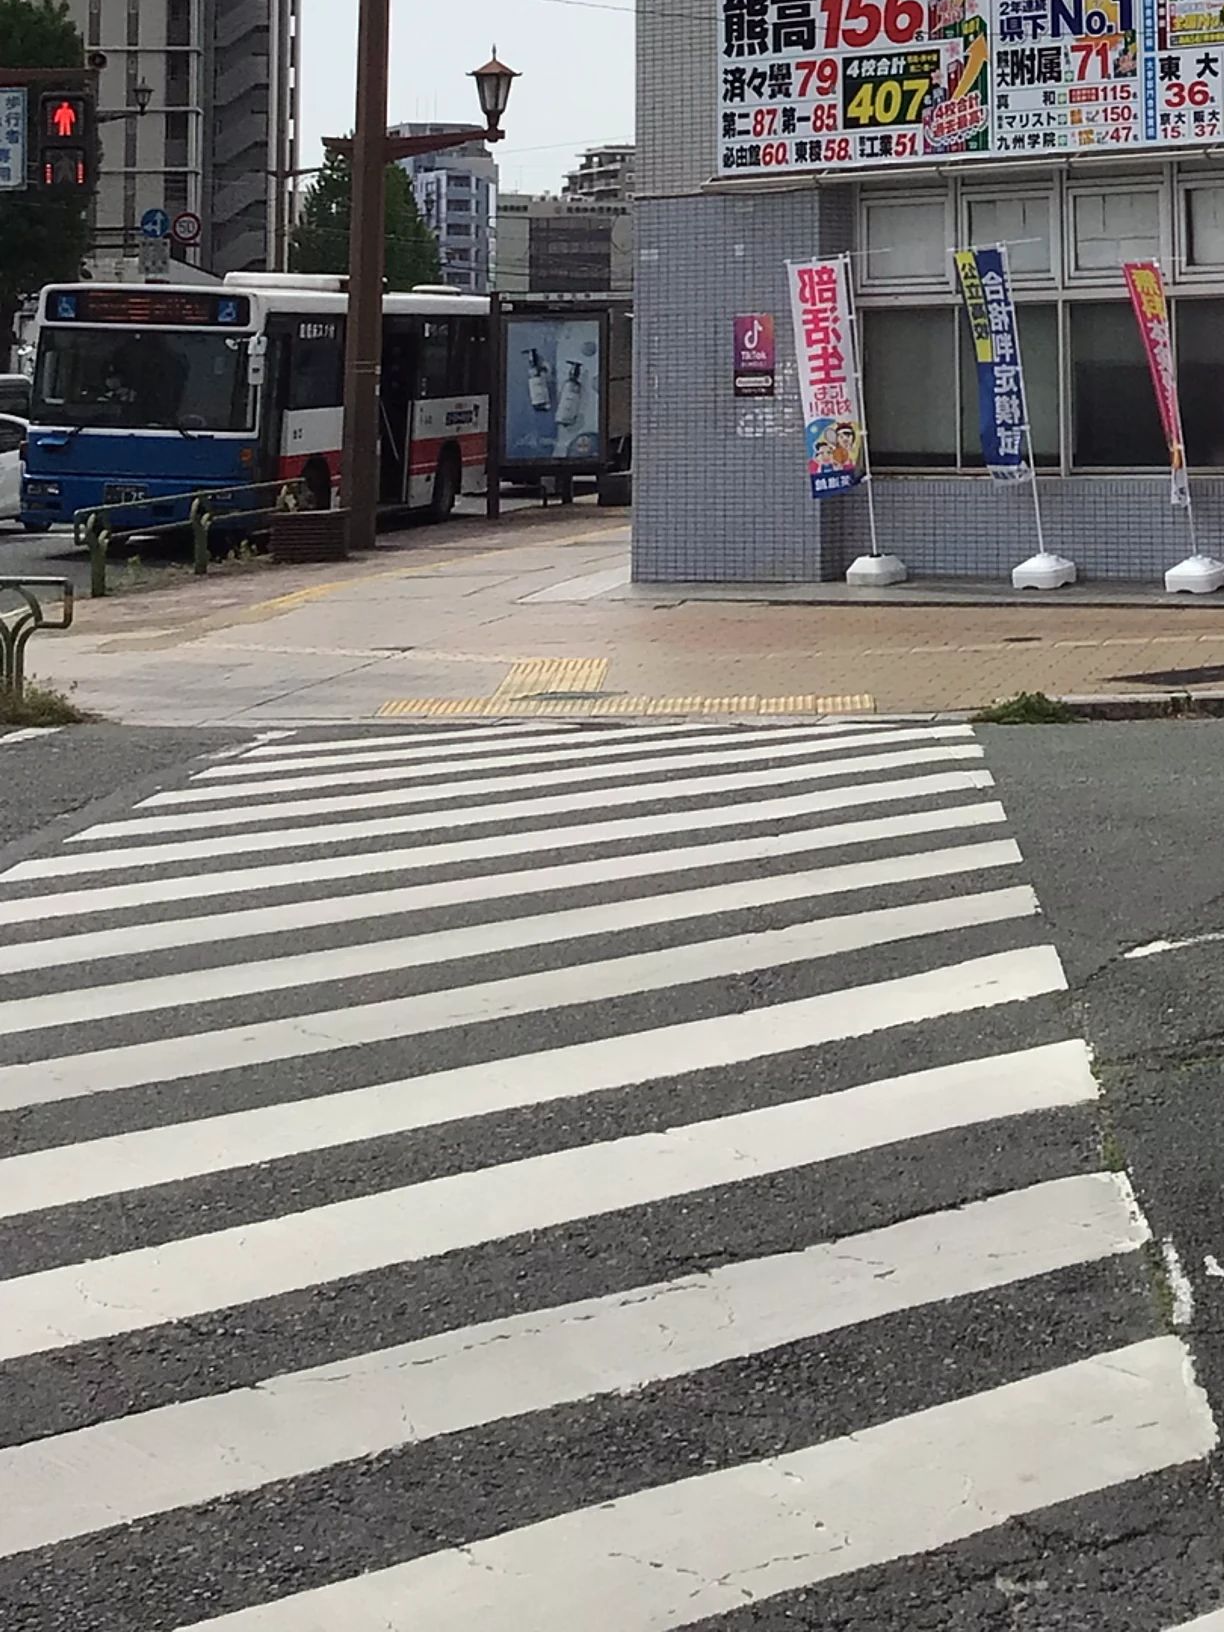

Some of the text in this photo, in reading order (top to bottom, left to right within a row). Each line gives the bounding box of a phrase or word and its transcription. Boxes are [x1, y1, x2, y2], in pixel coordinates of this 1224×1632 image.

[1070, 42, 1109, 81] 71
[795, 58, 838, 97] 79
[846, 78, 930, 125] 407
[1101, 84, 1131, 102] 115
[1164, 80, 1210, 108] 36
[752, 108, 778, 137] 87
[812, 103, 838, 133] 85
[1102, 105, 1133, 123] 150
[894, 132, 917, 157] 51
[1109, 126, 1133, 143] 47
[762, 141, 787, 166] 60
[823, 137, 850, 162] 58
